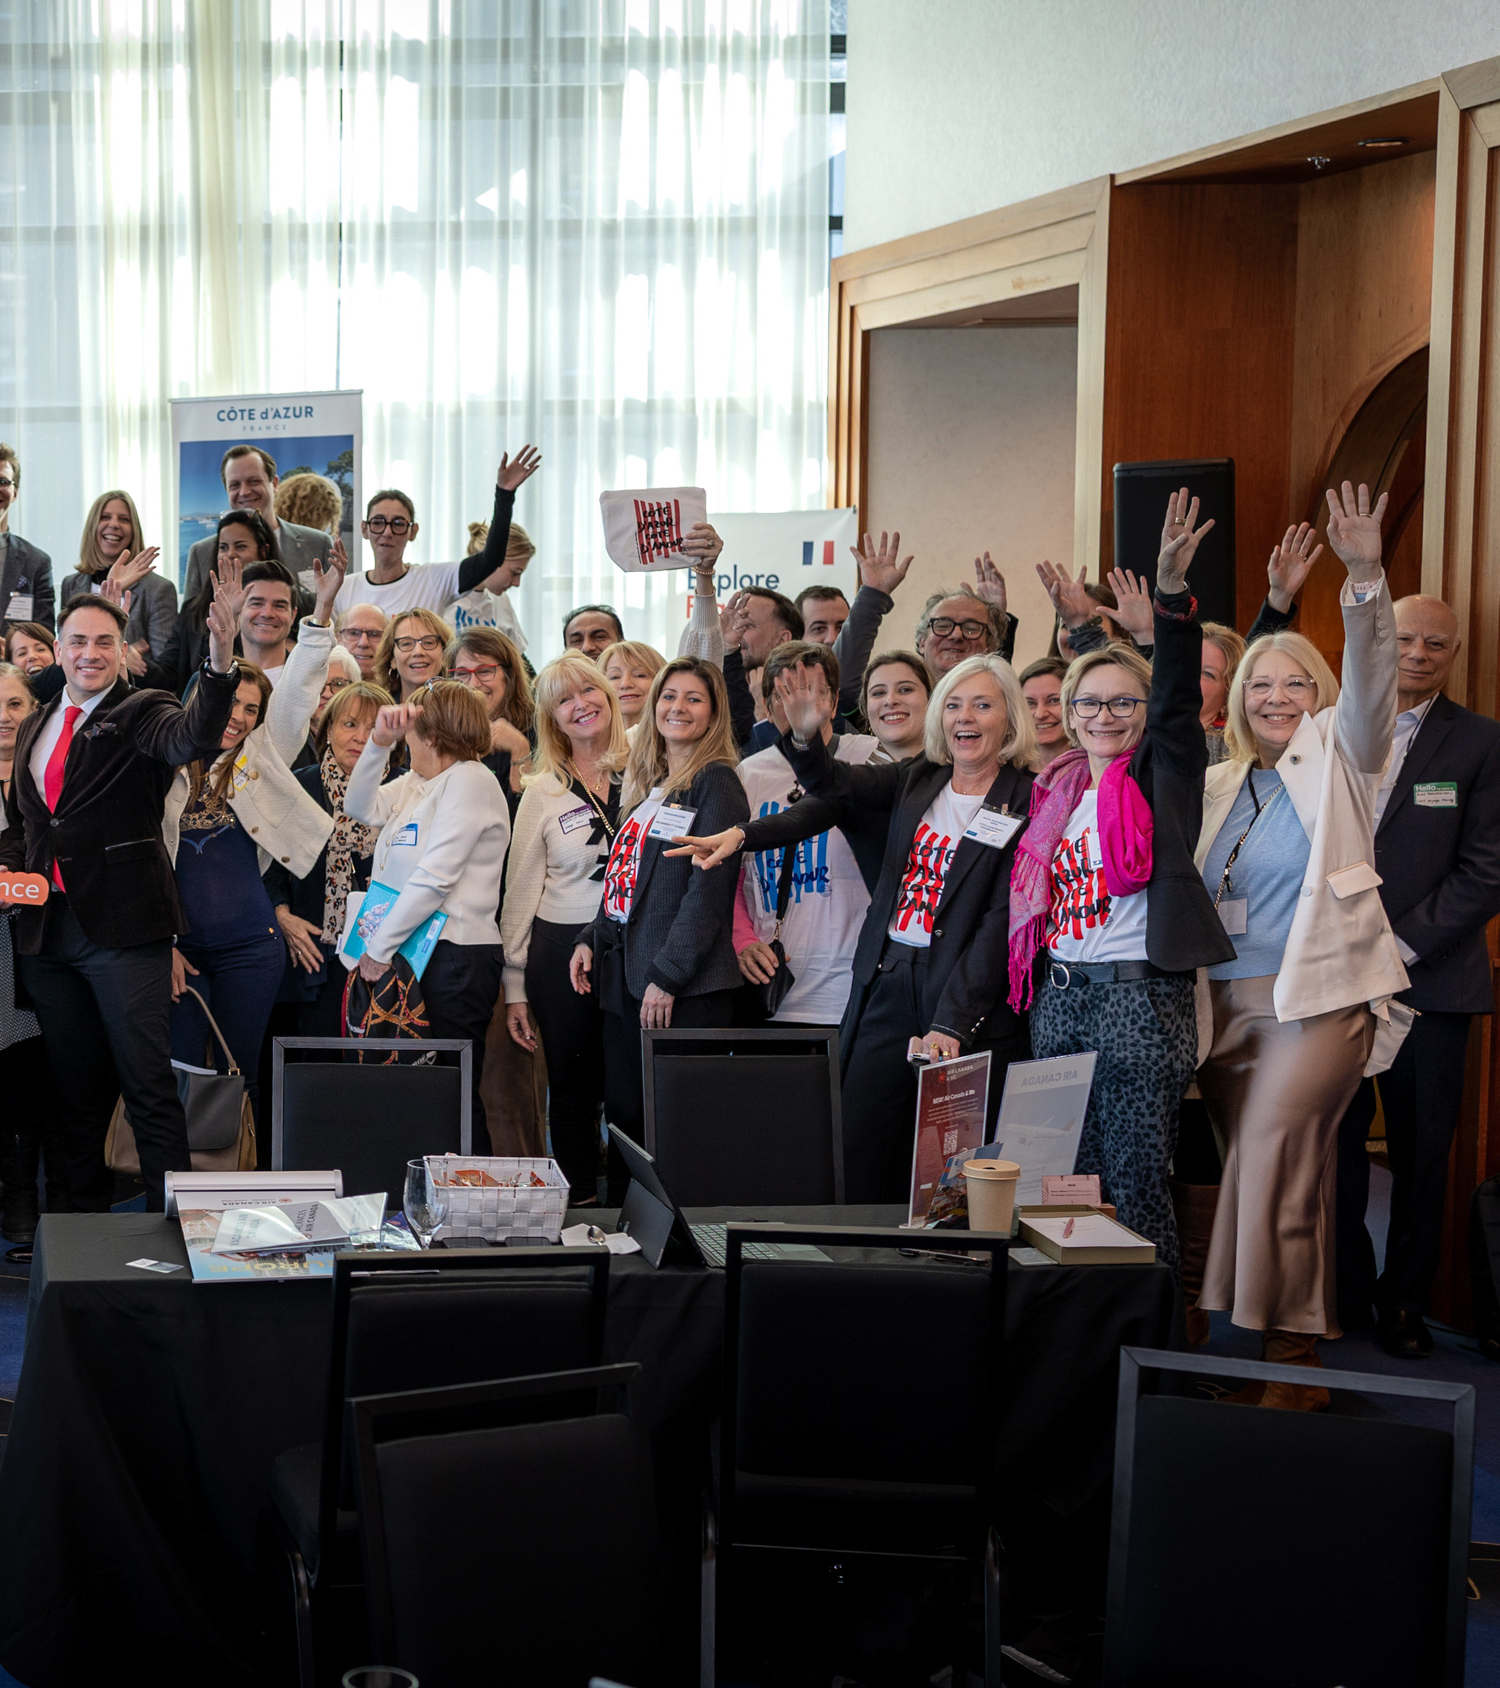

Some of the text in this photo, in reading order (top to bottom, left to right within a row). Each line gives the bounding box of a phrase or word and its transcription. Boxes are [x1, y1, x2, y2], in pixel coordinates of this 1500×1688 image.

[216, 405, 314, 422] CÔTE d'AZUR
[242, 424, 287, 432] FRANCE
[687, 564, 780, 597] Eplore
[766, 850, 808, 868] CÔE
